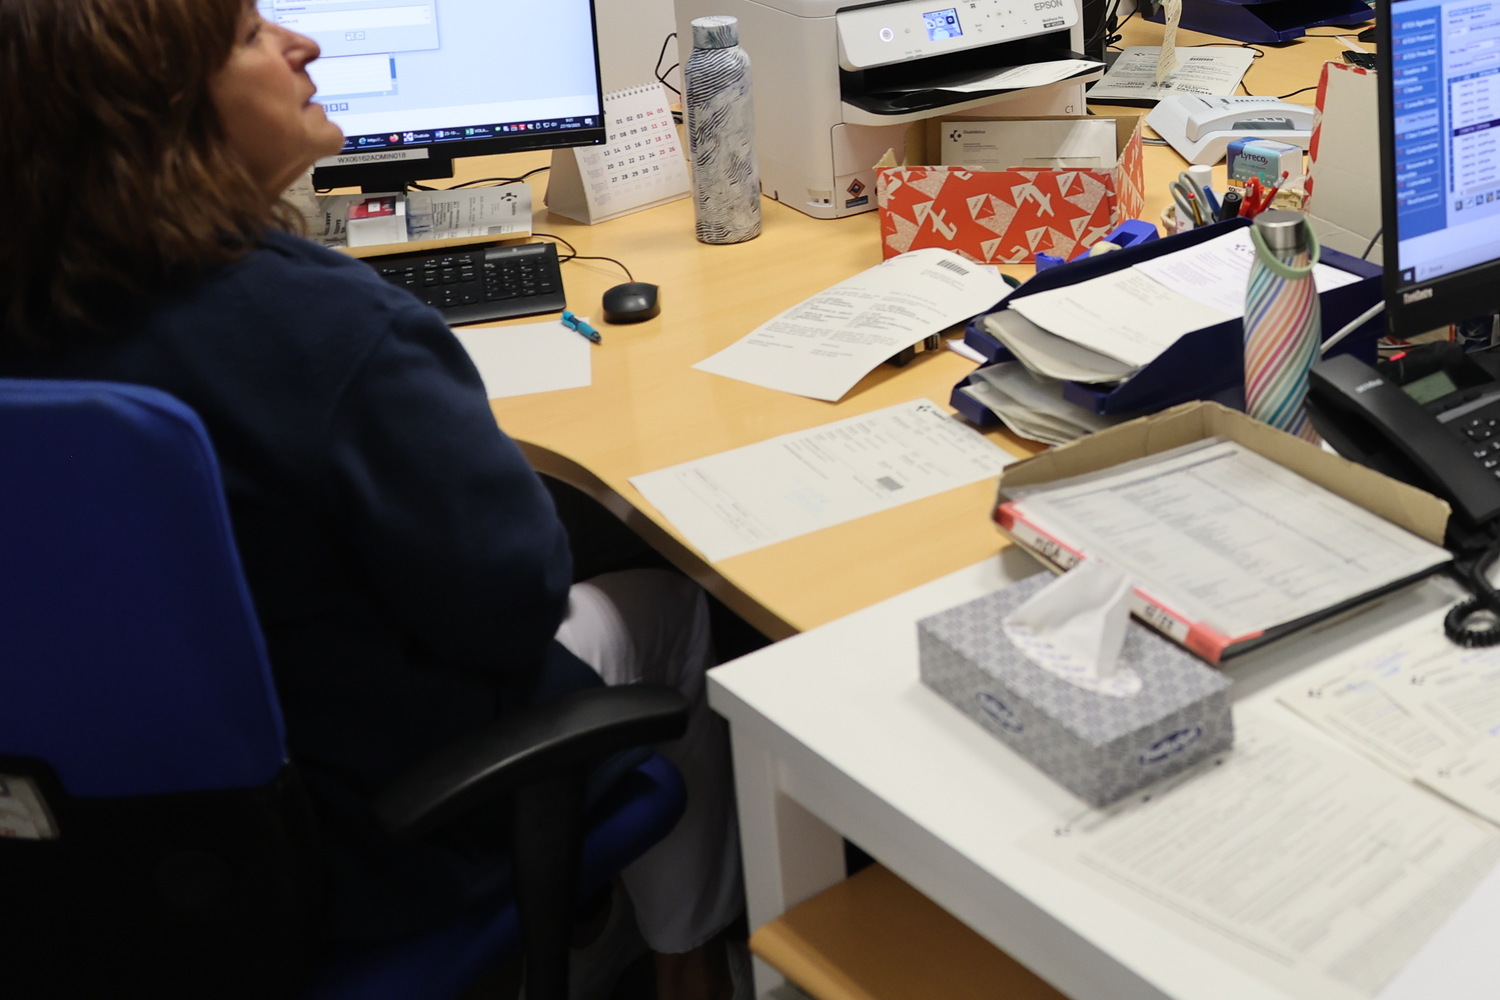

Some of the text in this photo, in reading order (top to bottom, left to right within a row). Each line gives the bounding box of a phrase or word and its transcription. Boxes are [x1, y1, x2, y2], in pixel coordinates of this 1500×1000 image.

[1034, 0, 1063, 12] EPSON
[1064, 104, 1074, 114] C1
[1240, 149, 1267, 165] Lyreco
